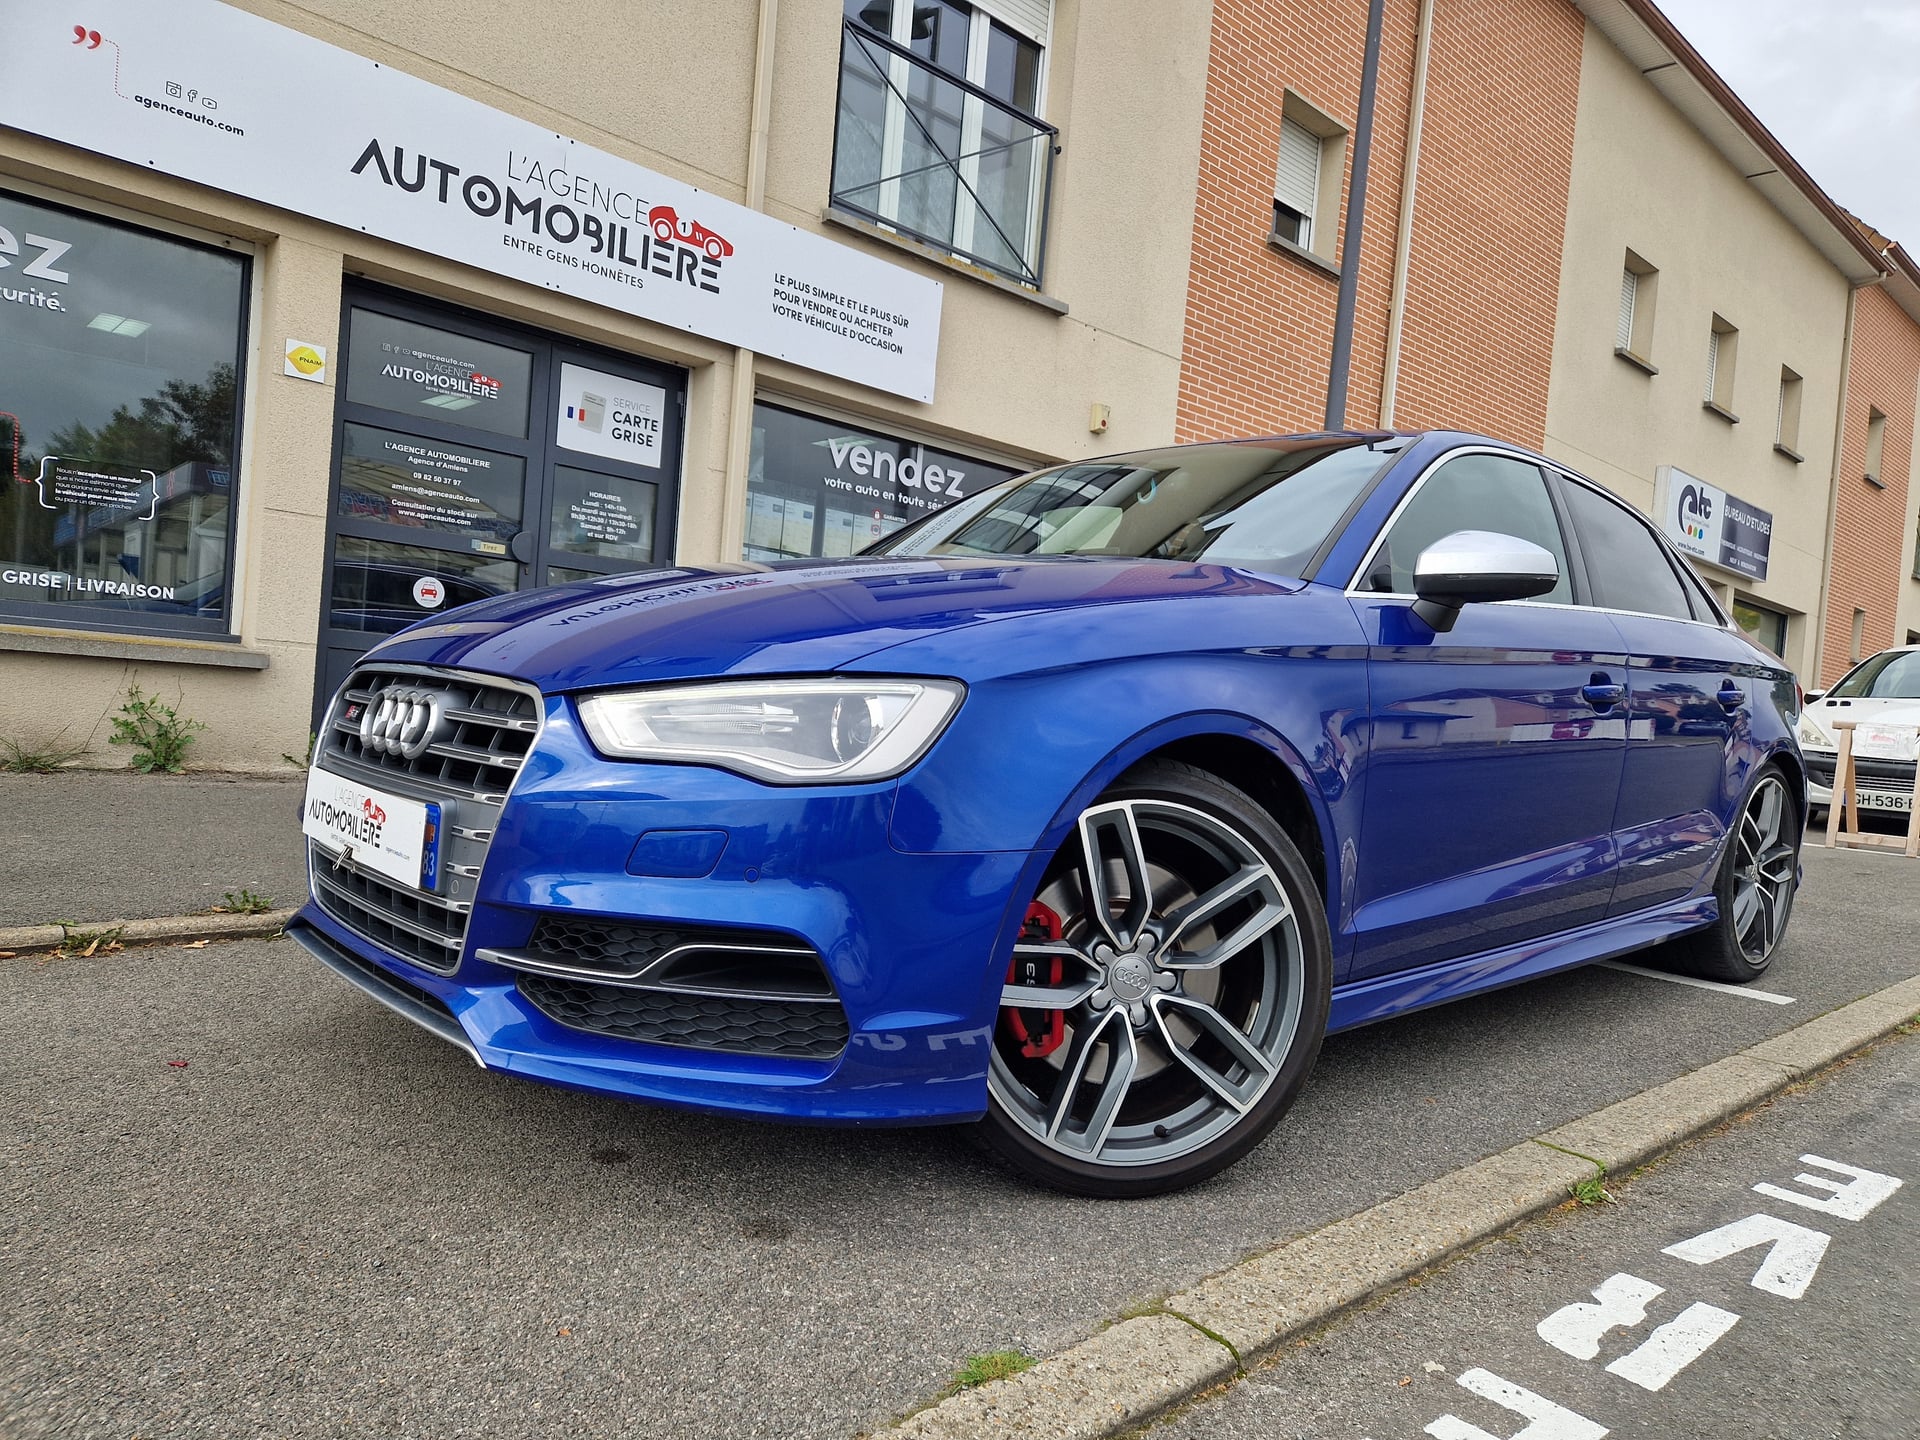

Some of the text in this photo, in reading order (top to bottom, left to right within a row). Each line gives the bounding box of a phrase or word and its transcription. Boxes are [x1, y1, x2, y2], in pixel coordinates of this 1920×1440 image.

[133, 93, 245, 137] agenceauto.com
[506, 150, 652, 227] L'AGENCE
[502, 234, 645, 289] ENTRE GENS HONNÊTES
[0, 287, 67, 313] urité.
[774, 273, 909, 328] LE PLUS SIMPLE ET LE PLUS SÛR
[773, 288, 893, 337] POUR VENDRE OU ACHETER
[772, 303, 903, 355] VOTRE VÉHICULE D'OCCASION
[298, 355, 323, 367] FNAIM
[411, 349, 476, 369] agenceauto.com
[425, 361, 473, 379] L'AGENCE
[612, 396, 651, 414] SERVICE
[612, 410, 659, 433] CARTE
[611, 427, 654, 448] GRISE
[384, 441, 491, 469] L'AGENCE AUTOMOBILIERE
[407, 455, 469, 473] Agence d'Amiens
[423, 473, 432, 481] 82
[433, 475, 442, 483] 50
[443, 477, 451, 485] 37
[828, 438, 966, 498] vendez
[391, 482, 480, 504] amiens@agenceauto.com
[589, 491, 621, 502] HORAIRES
[823, 477, 852, 492] votre
[855, 483, 879, 498] auto
[882, 490, 895, 502] en
[898, 492, 925, 507] toute
[391, 498, 435, 512] Consultation
[436, 506, 446, 514] du
[447, 508, 465, 517] stock
[397, 509, 472, 526] www.agenceauto.com
[1724, 504, 1746, 525] BUREAU
[2, 570, 62, 588] GRISE
[76, 577, 175, 600] LIVRAISON
[422, 850, 435, 877] 83
